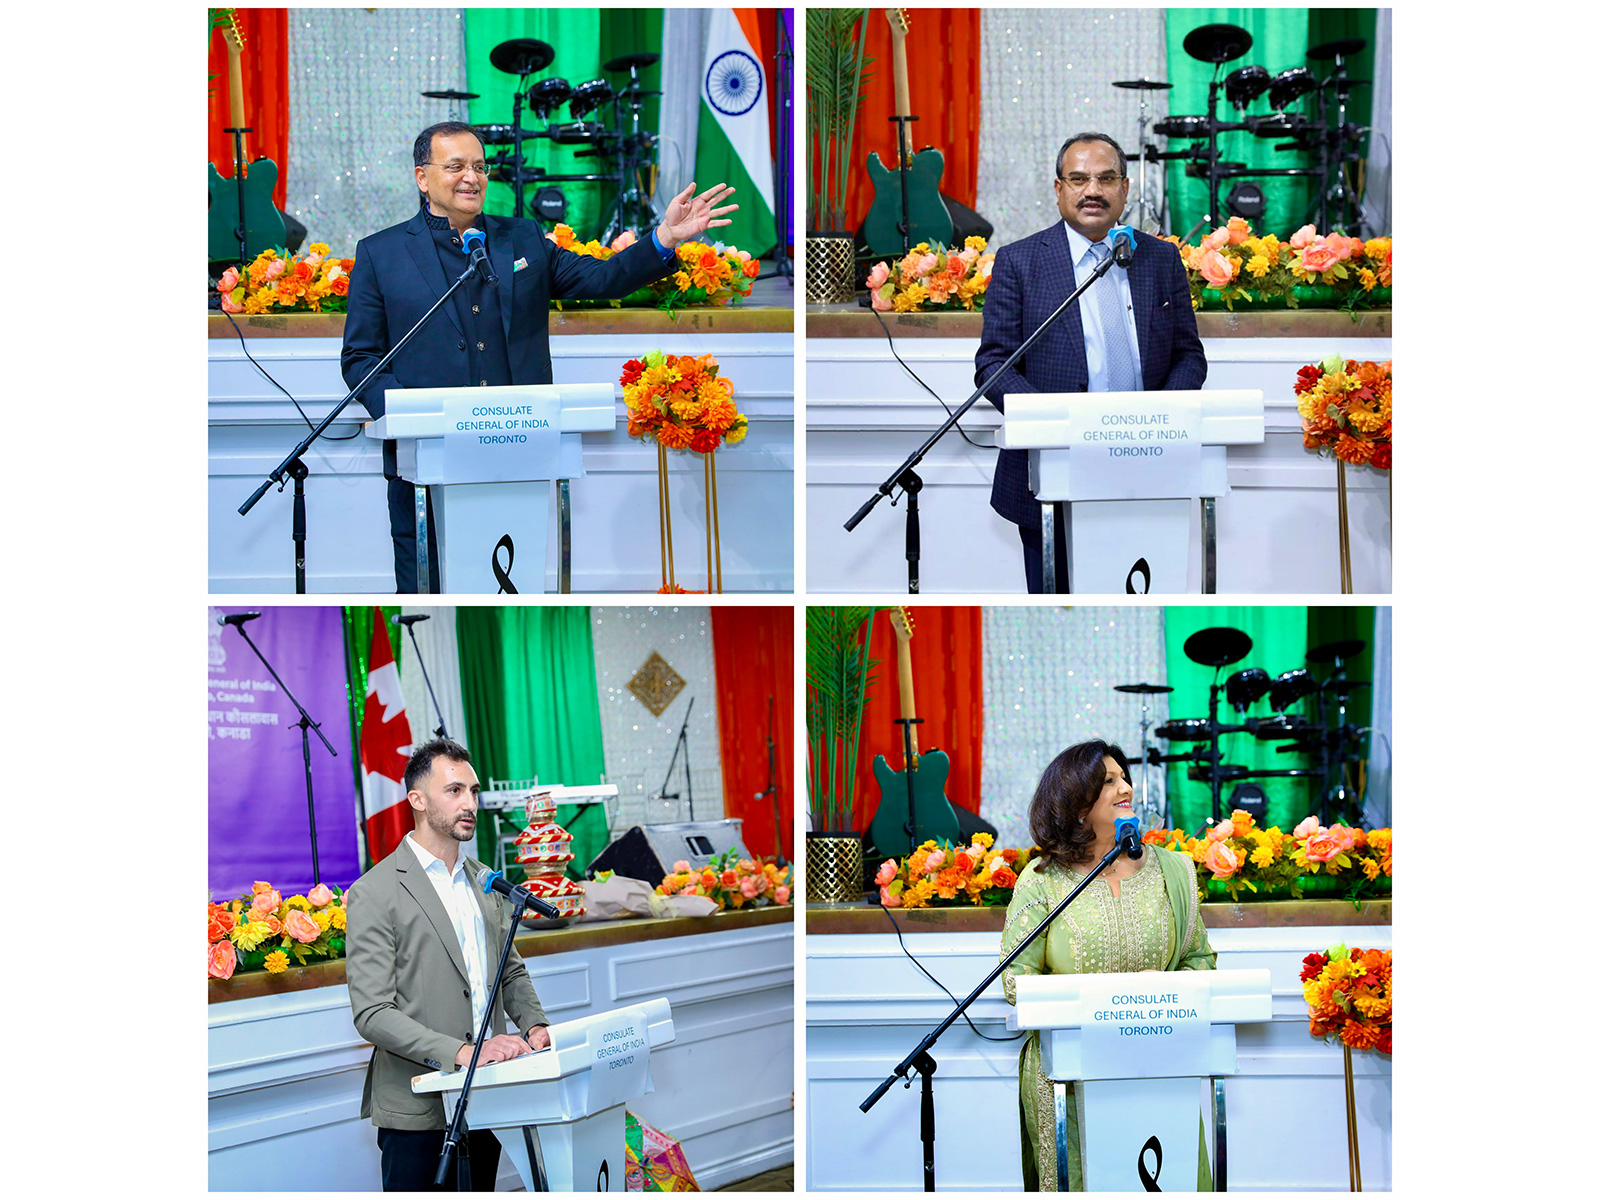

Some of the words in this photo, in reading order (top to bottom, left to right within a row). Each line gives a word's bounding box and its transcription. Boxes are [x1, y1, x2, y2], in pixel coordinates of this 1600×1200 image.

[471, 405, 533, 417] CONSULATE
[456, 420, 504, 431] GENERAL
[505, 419, 519, 430] OF
[521, 419, 550, 429] INDIA
[1101, 414, 1170, 426] CONSULATE
[478, 434, 528, 445] TORONTO
[1083, 430, 1136, 441] GENERAL
[1138, 429, 1154, 440] OF
[1157, 429, 1189, 440] INDIA
[1108, 446, 1164, 457] TORONTO
[208, 678, 239, 690] eneral
[239, 679, 251, 691] of
[251, 680, 277, 692] India
[216, 691, 255, 703] Canada
[1111, 993, 1179, 1005] CONSULATE
[1094, 1010, 1147, 1021] GENERAL
[1148, 1009, 1164, 1020] OF
[1166, 1008, 1198, 1019] INDIA
[602, 1026, 635, 1043] CONSULATE
[1118, 1025, 1173, 1036] TORONTO
[596, 1044, 622, 1059] GENERAL
[622, 1041, 630, 1052] OF
[630, 1038, 646, 1050] INDIA
[608, 1055, 635, 1071] TORONTO
